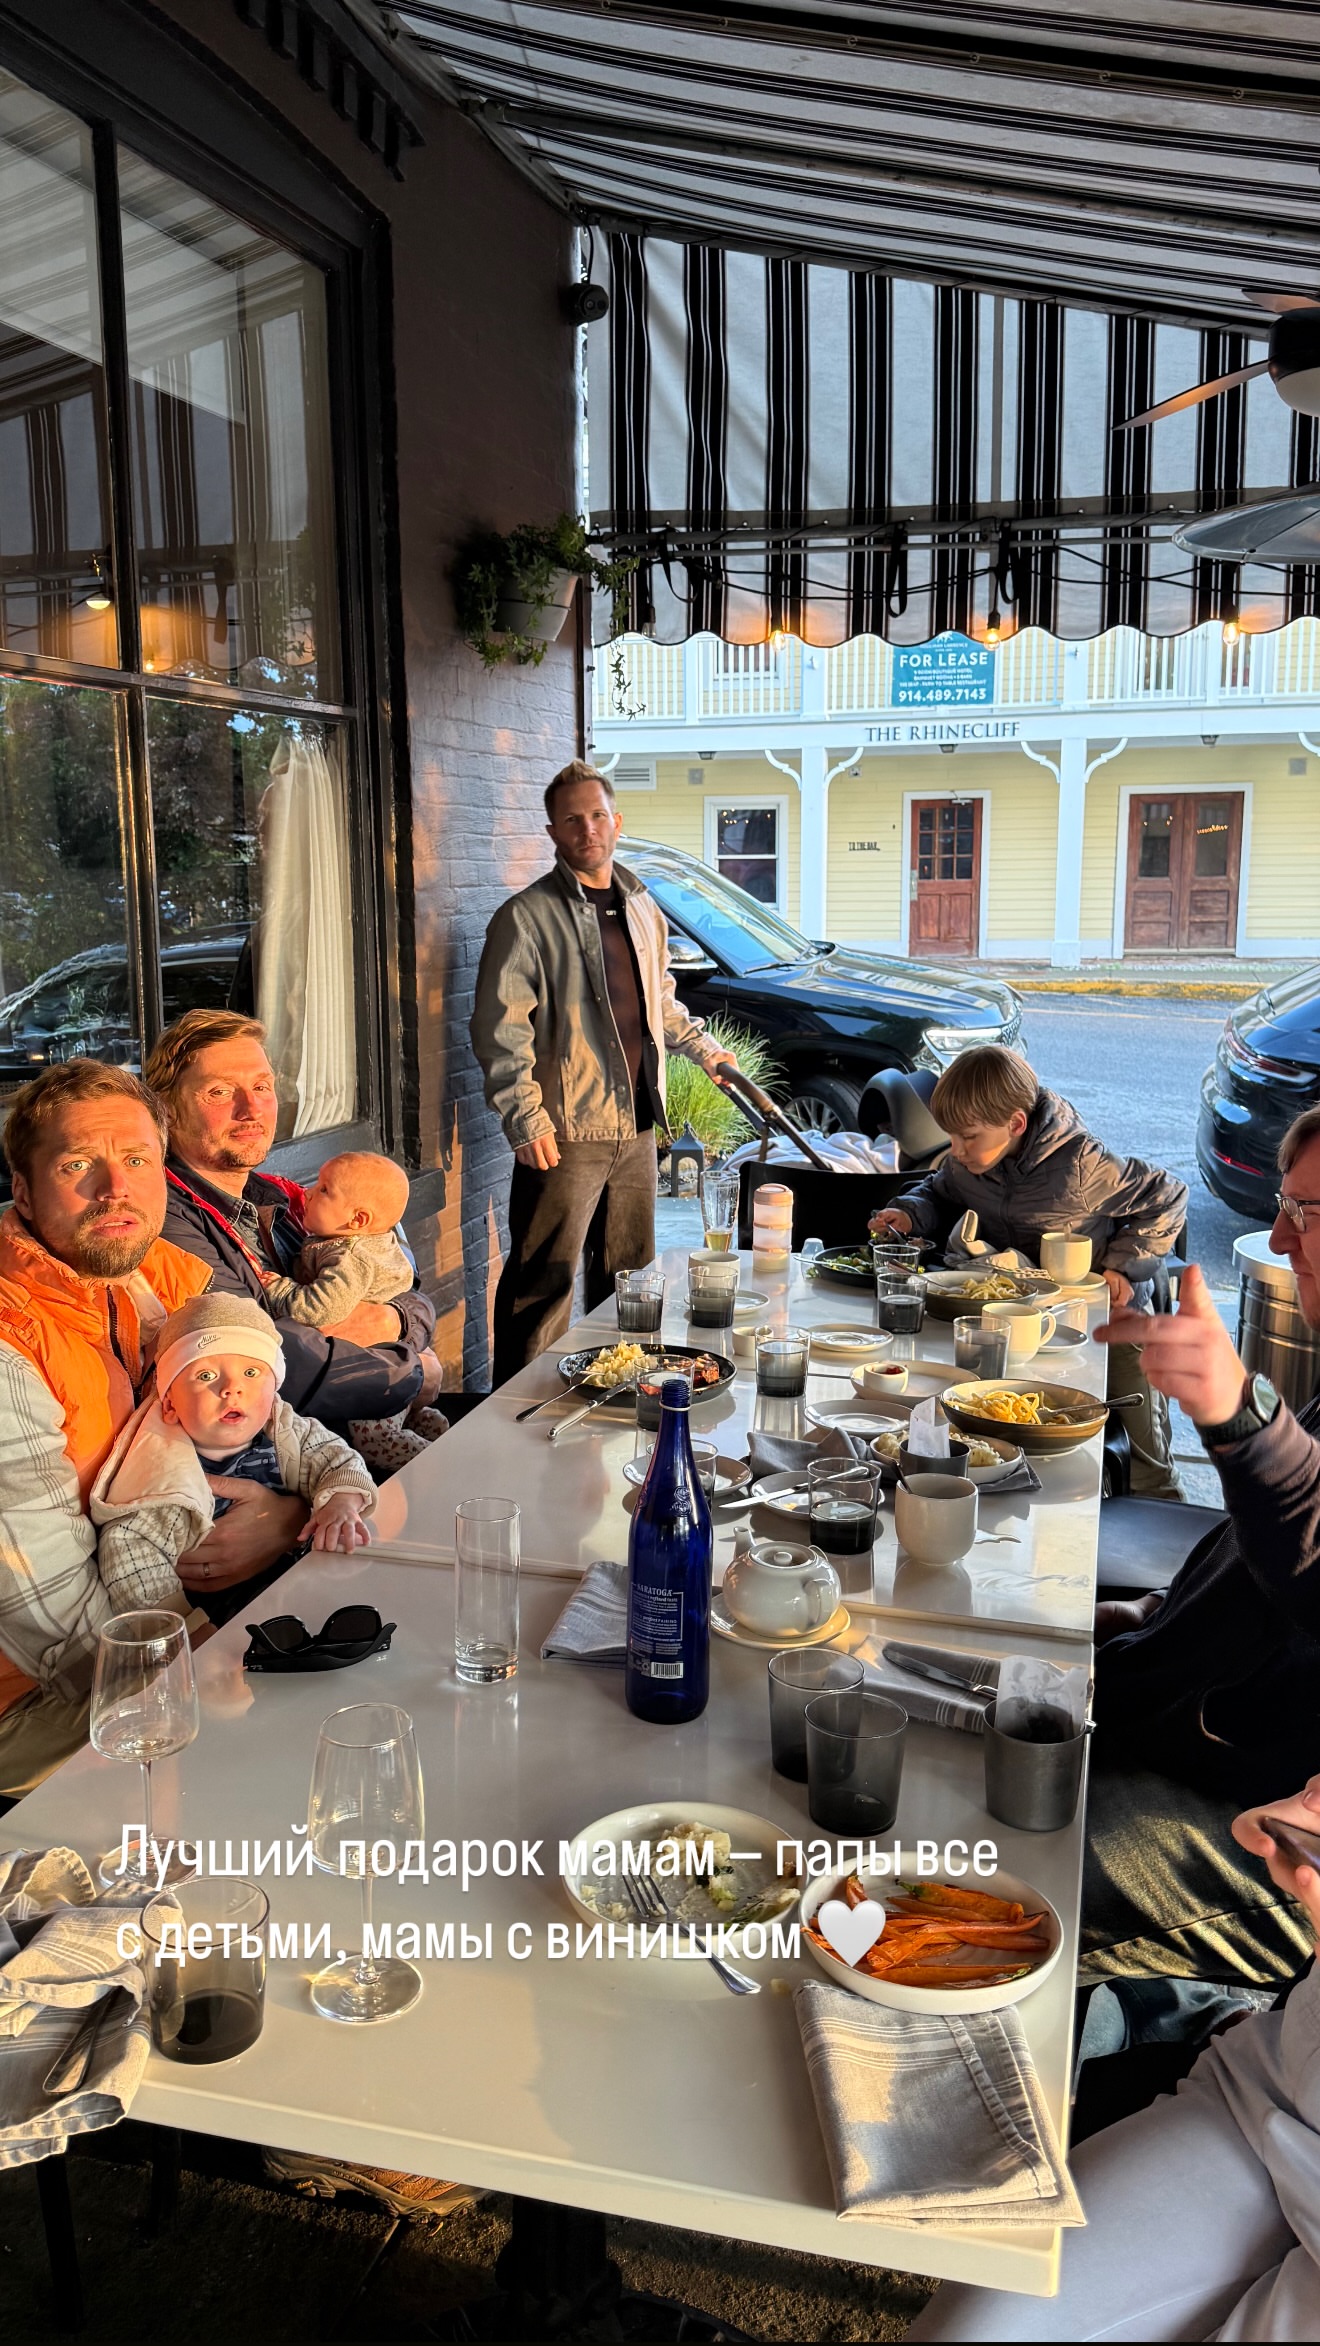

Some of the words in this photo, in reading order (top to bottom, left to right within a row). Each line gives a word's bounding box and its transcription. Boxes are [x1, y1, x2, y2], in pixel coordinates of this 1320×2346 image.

[900, 654, 932, 668] FOR
[938, 652, 988, 666] LEASE
[898, 688, 987, 702] 914.489.7143
[865, 727, 901, 741] THE
[910, 722, 1020, 740] RHINECLIFF
[637, 1584, 672, 1596] SARATOGA
